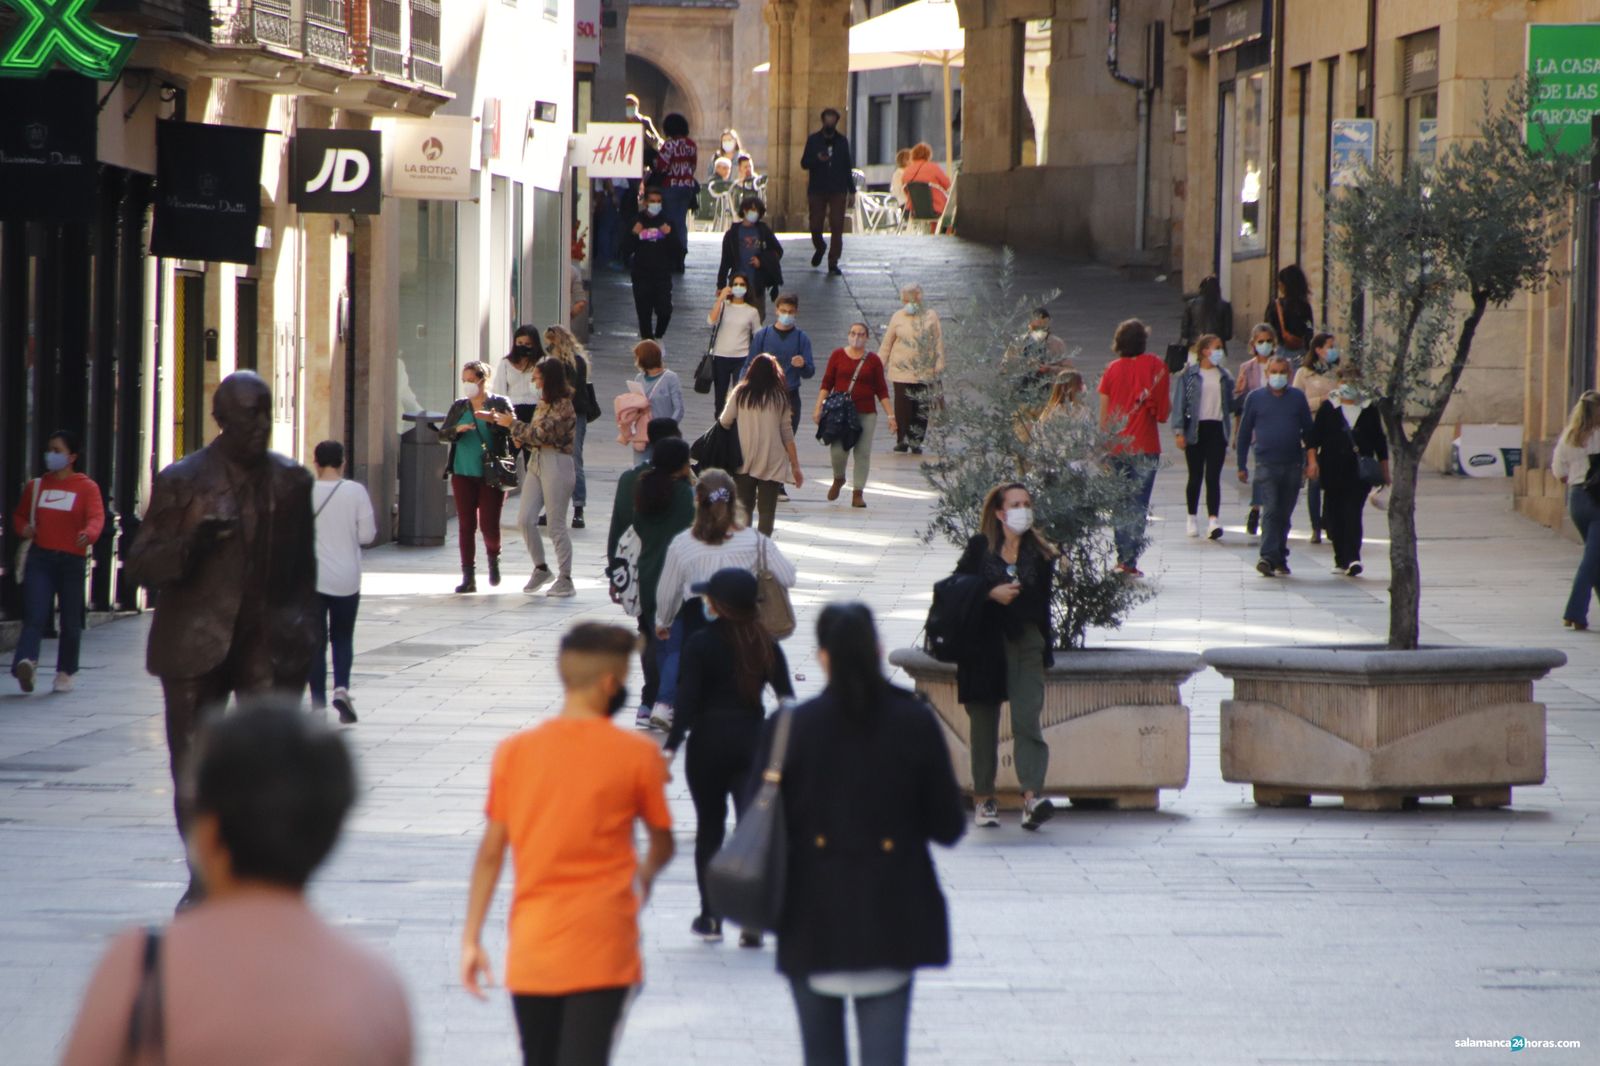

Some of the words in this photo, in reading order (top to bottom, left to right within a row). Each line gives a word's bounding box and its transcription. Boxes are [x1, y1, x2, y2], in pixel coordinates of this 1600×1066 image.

[1536, 58, 1558, 74] LA
[1539, 84, 1562, 99] DE
[1566, 84, 1598, 99] LAS
[1531, 108, 1600, 124] CARCASA
[592, 136, 637, 165] H&M
[305, 148, 370, 193] JD
[404, 163, 417, 173] LA
[420, 165, 458, 175] BOTICA
